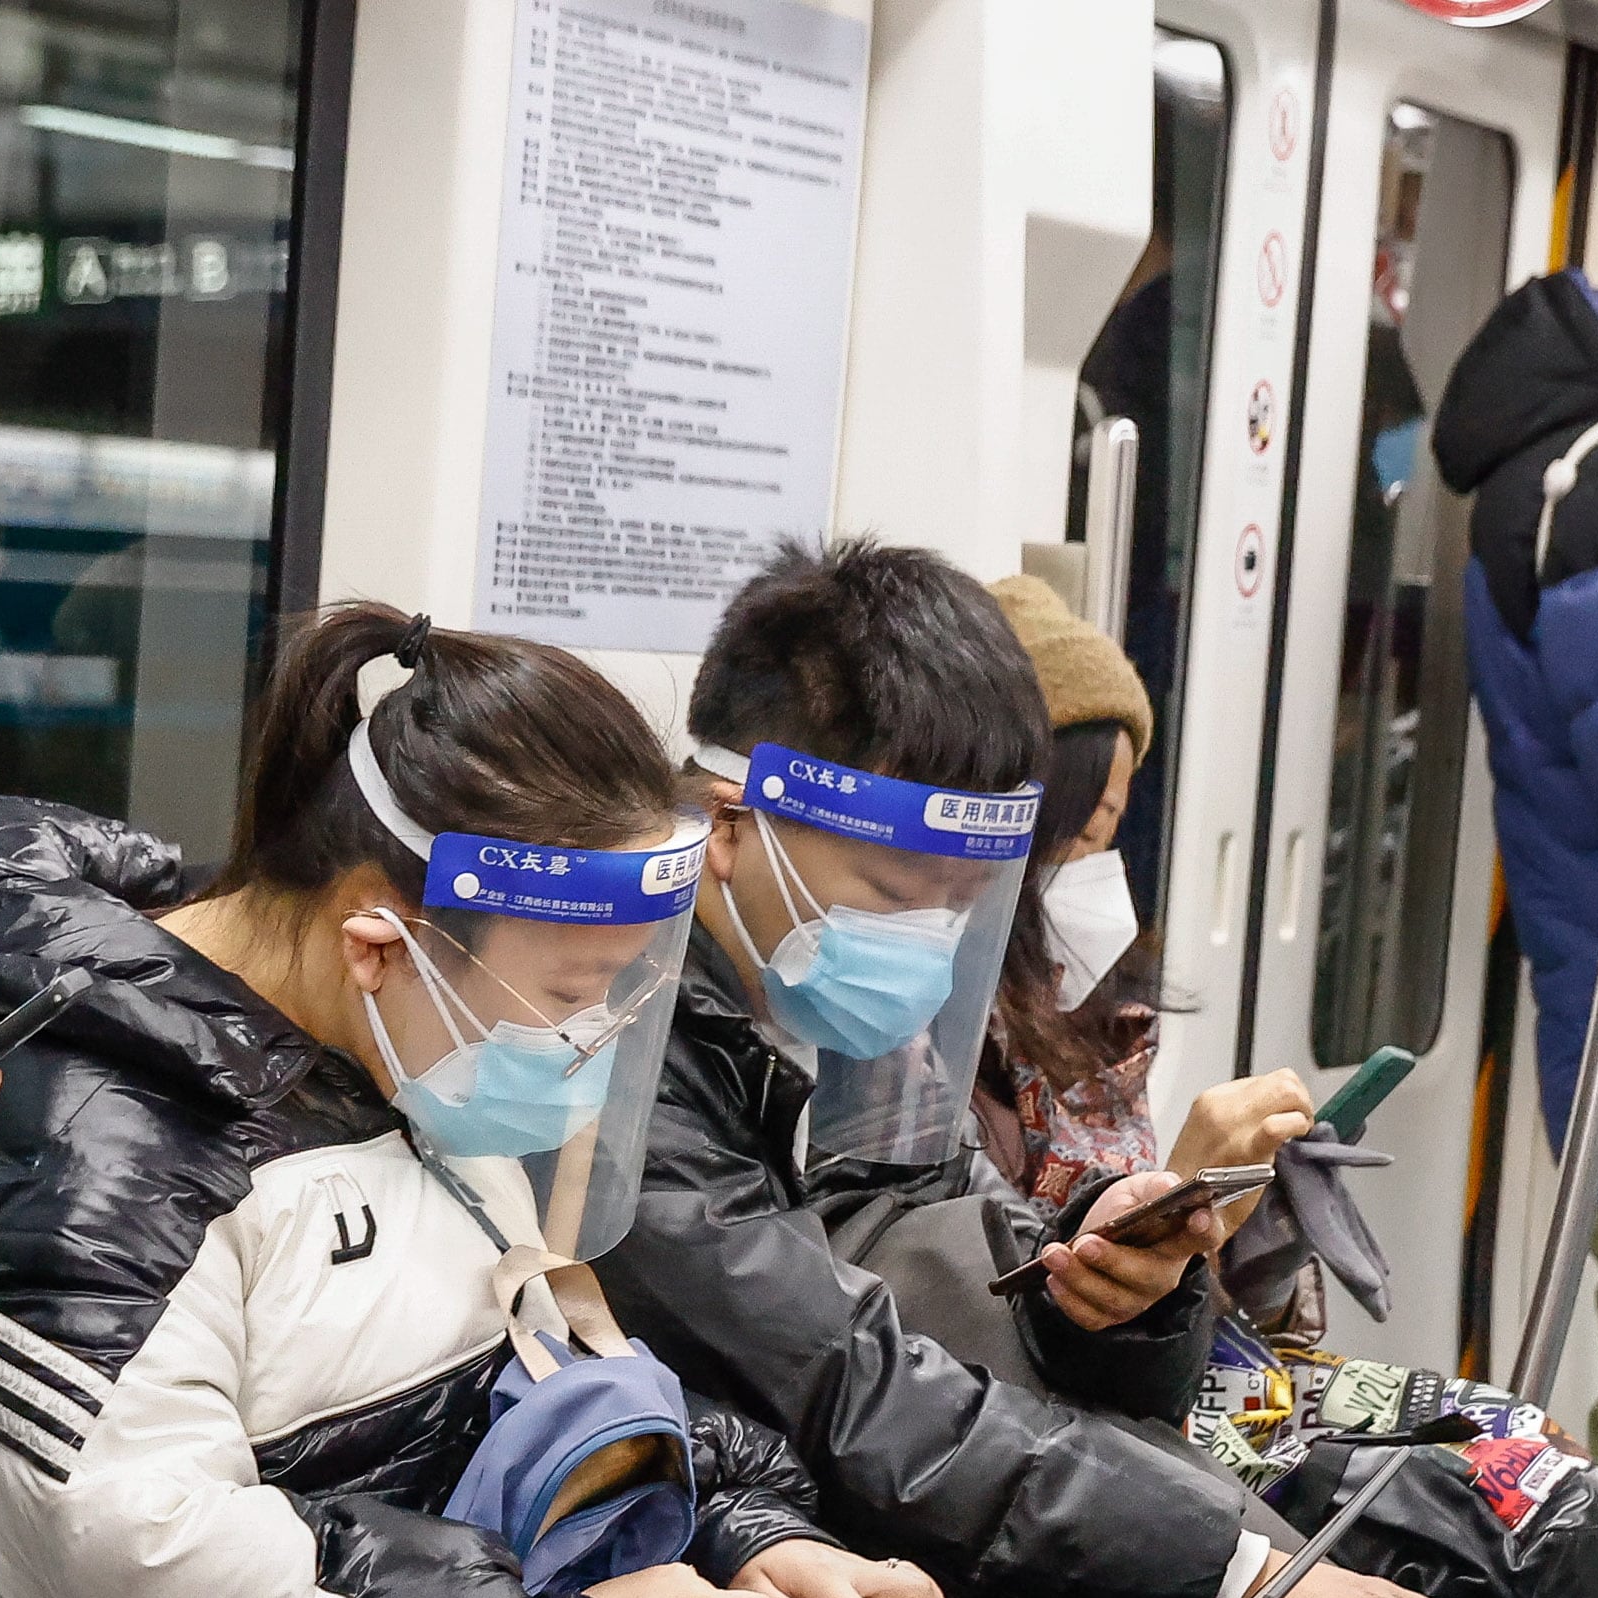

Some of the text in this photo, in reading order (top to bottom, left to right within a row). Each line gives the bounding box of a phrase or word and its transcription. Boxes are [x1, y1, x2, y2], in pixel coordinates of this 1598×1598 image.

[66, 246, 108, 297] A
[789, 759, 858, 795] CX长喜
[478, 845, 572, 876] CX长喜
